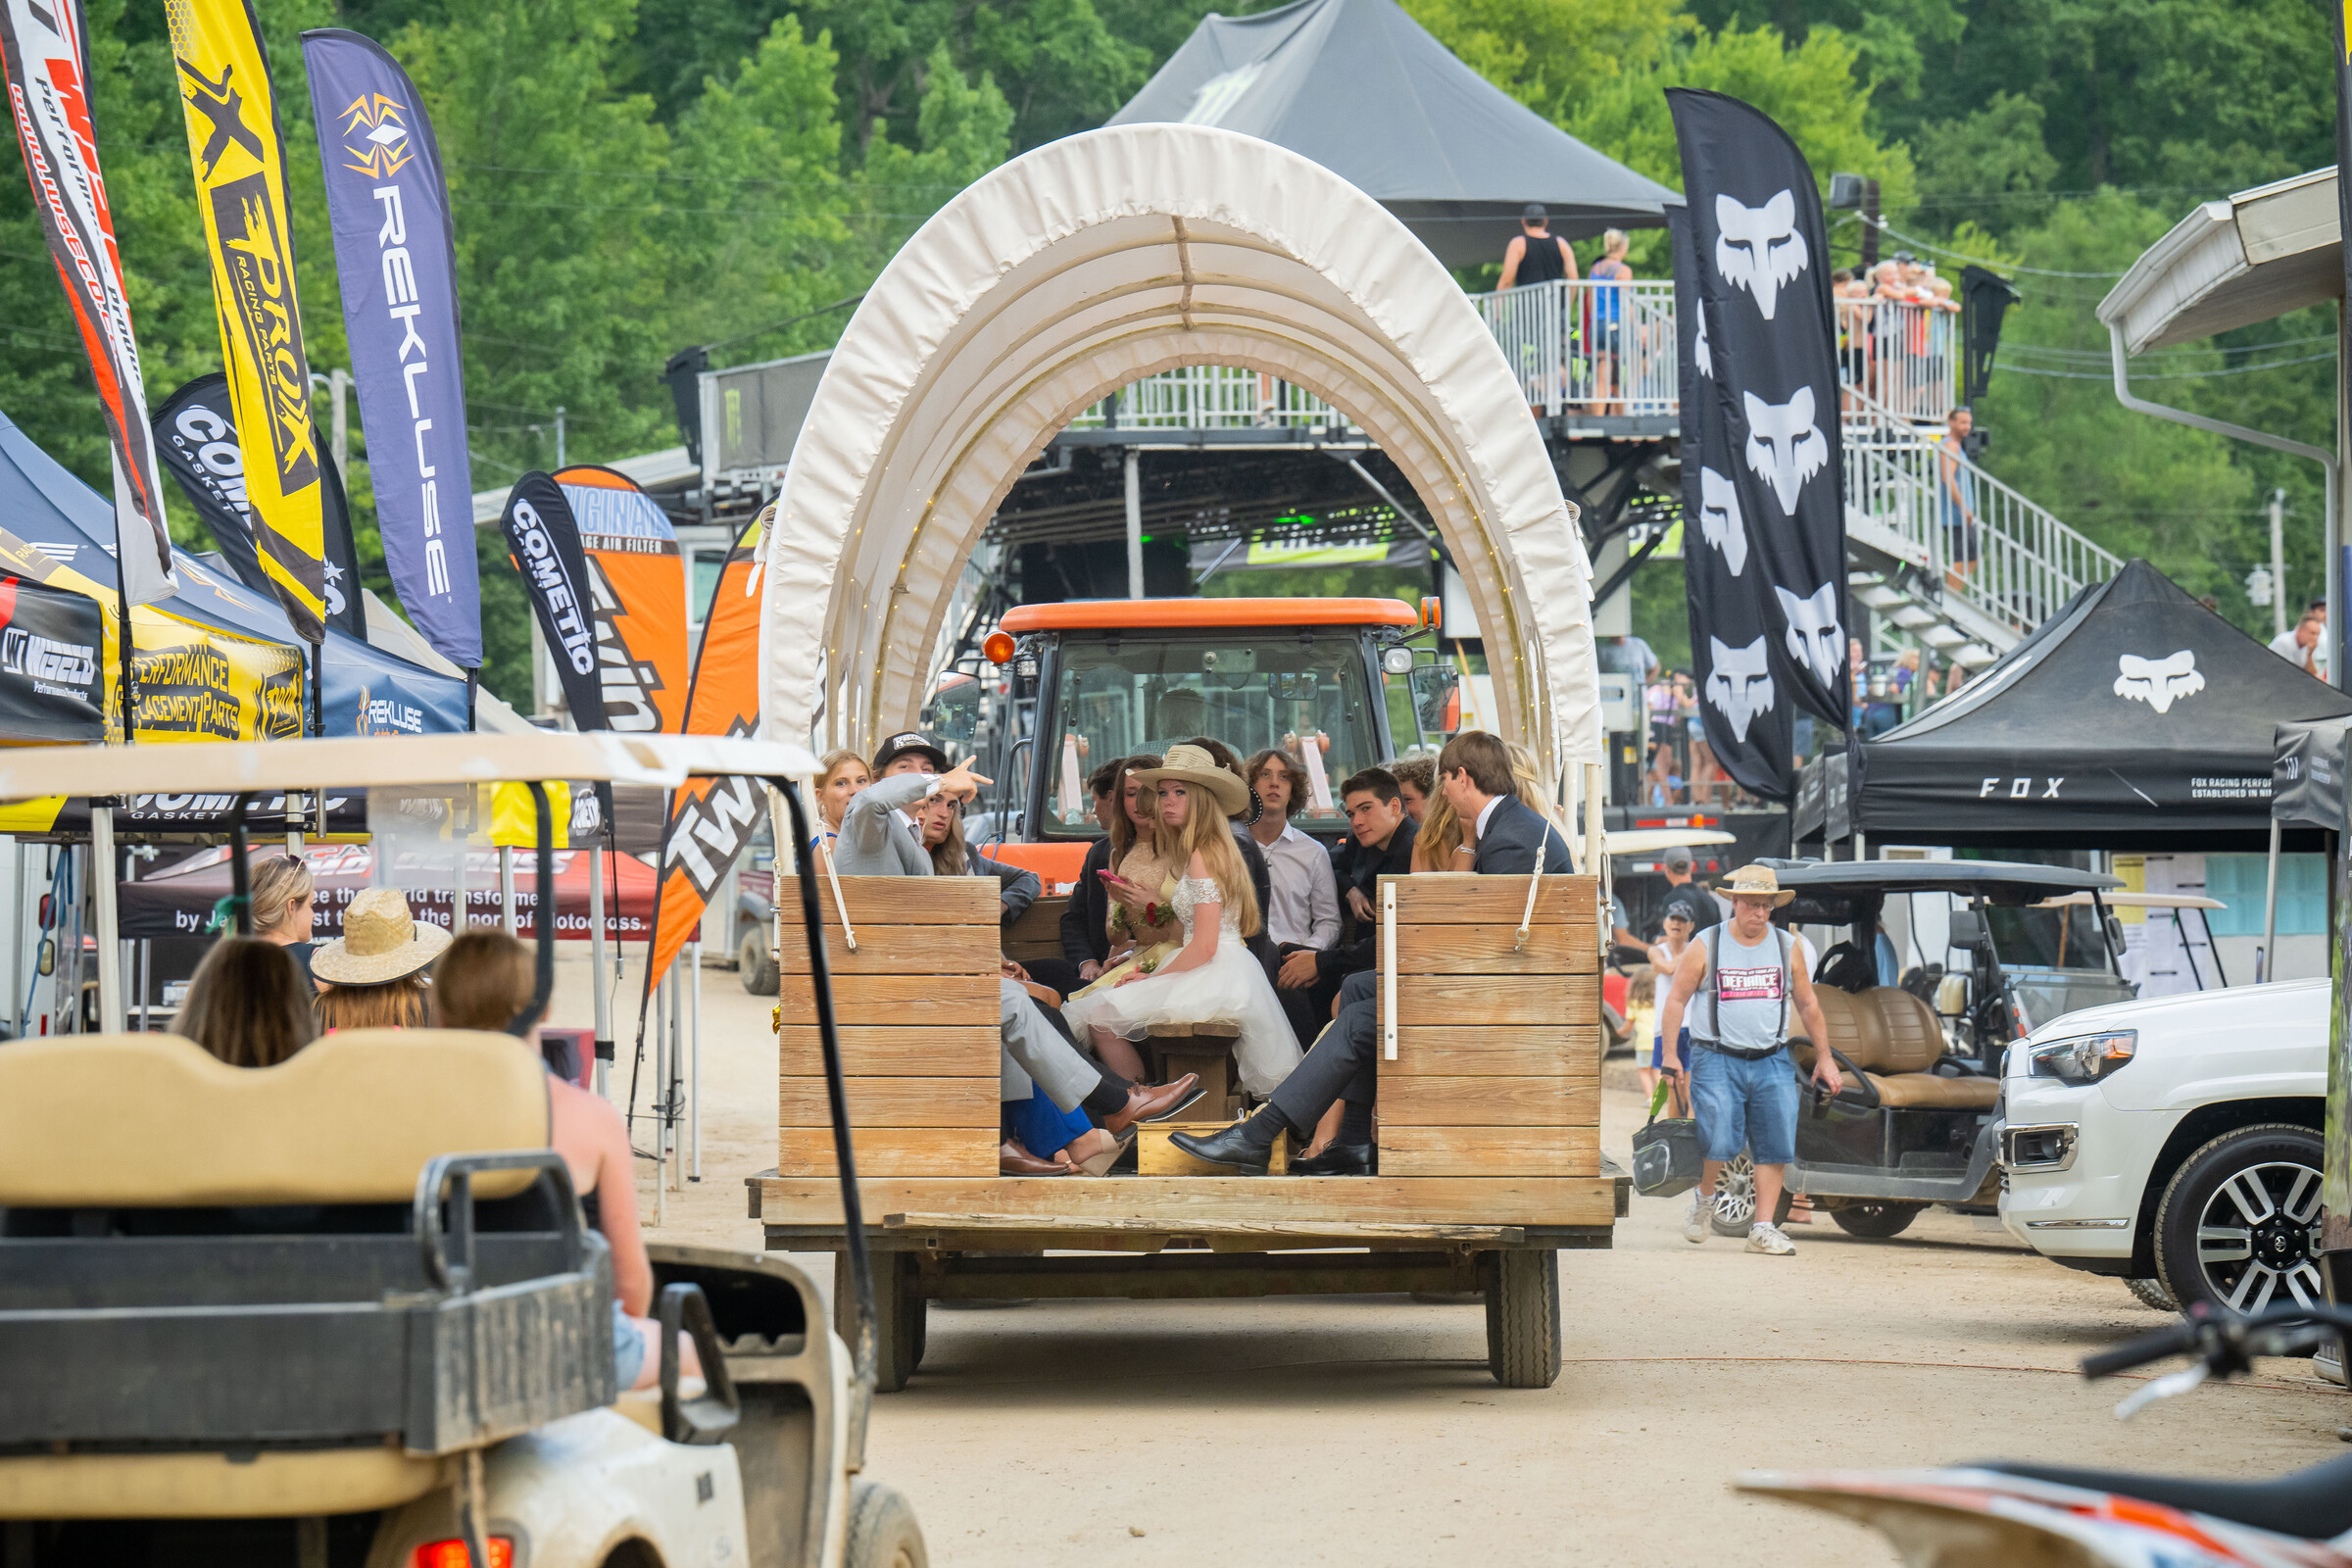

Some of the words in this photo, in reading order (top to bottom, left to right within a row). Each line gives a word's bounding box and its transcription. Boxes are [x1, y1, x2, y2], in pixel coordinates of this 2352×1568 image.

[225, 190, 318, 475] PROX
[236, 256, 264, 324] RACING
[259, 328, 277, 385] PARTS
[372, 184, 451, 597] REKLUSE
[172, 434, 235, 513] GASKET
[602, 537, 622, 552] AIR
[625, 538, 662, 555] FILTER
[513, 498, 595, 676] COMETIC
[114, 684, 200, 728] RLACEMENT
[368, 699, 423, 733] REKLUSE
[1980, 777, 2064, 798] FOX
[2191, 778, 2208, 788] FOX
[2209, 778, 2240, 788] RACING
[2191, 788, 2247, 799] ESTABLISHED
[2248, 789, 2258, 798] IN
[130, 811, 221, 820] GASKET
[313, 889, 330, 905] ee
[434, 887, 539, 906] transfome
[175, 910, 200, 932] by
[419, 907, 451, 926] the
[515, 909, 534, 928] of
[552, 911, 647, 930] otocoss.
[1722, 974, 1778, 988] DEFIANCE
